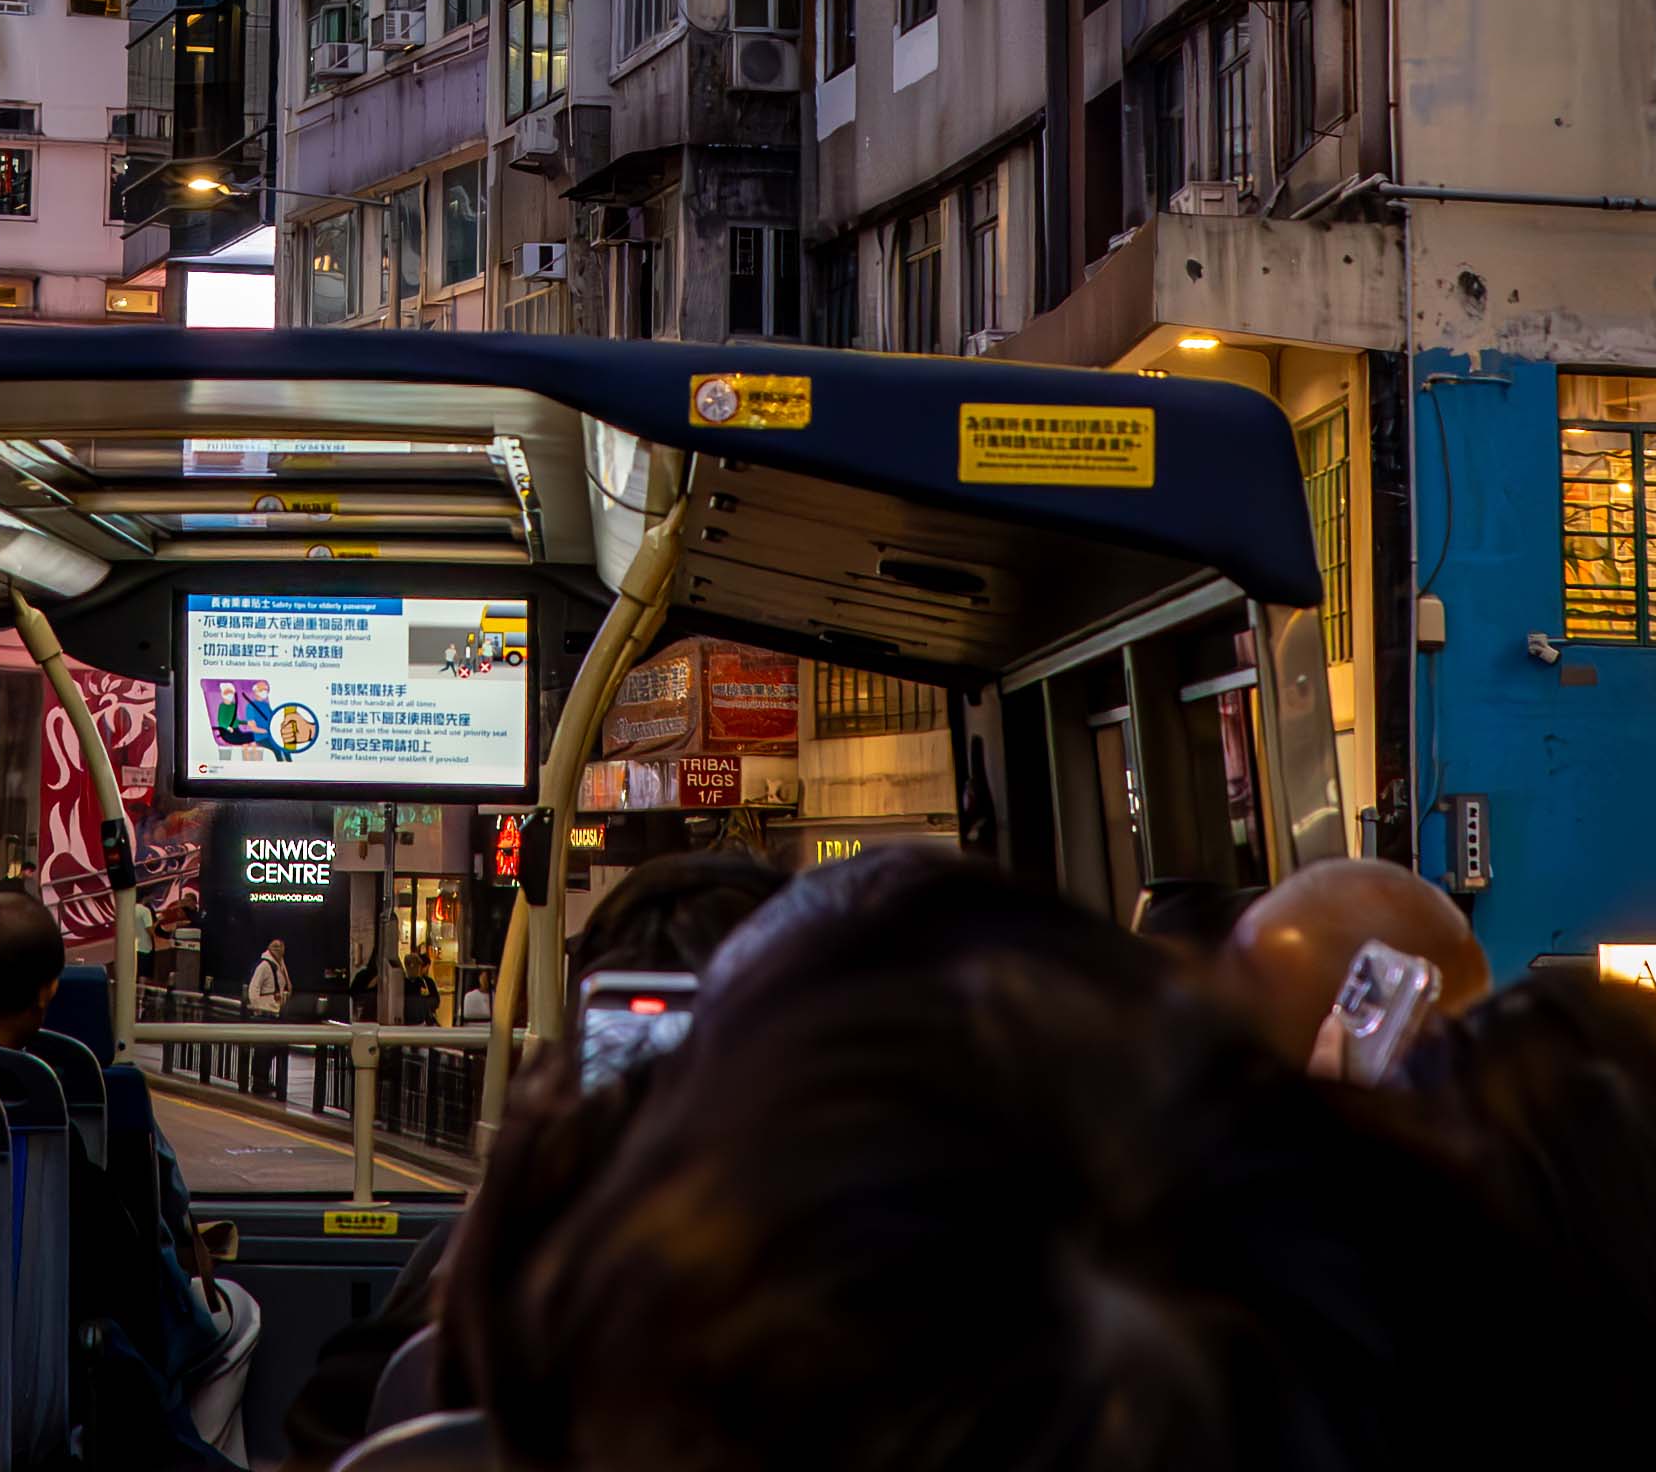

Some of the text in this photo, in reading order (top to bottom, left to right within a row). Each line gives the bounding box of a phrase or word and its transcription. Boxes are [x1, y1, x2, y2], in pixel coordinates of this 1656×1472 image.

[680, 758, 739, 772] TRIBAL
[687, 773, 735, 787] RUGS
[698, 791, 723, 804] 1/F
[245, 839, 336, 861] KINWICK
[246, 862, 331, 885] CENTRE
